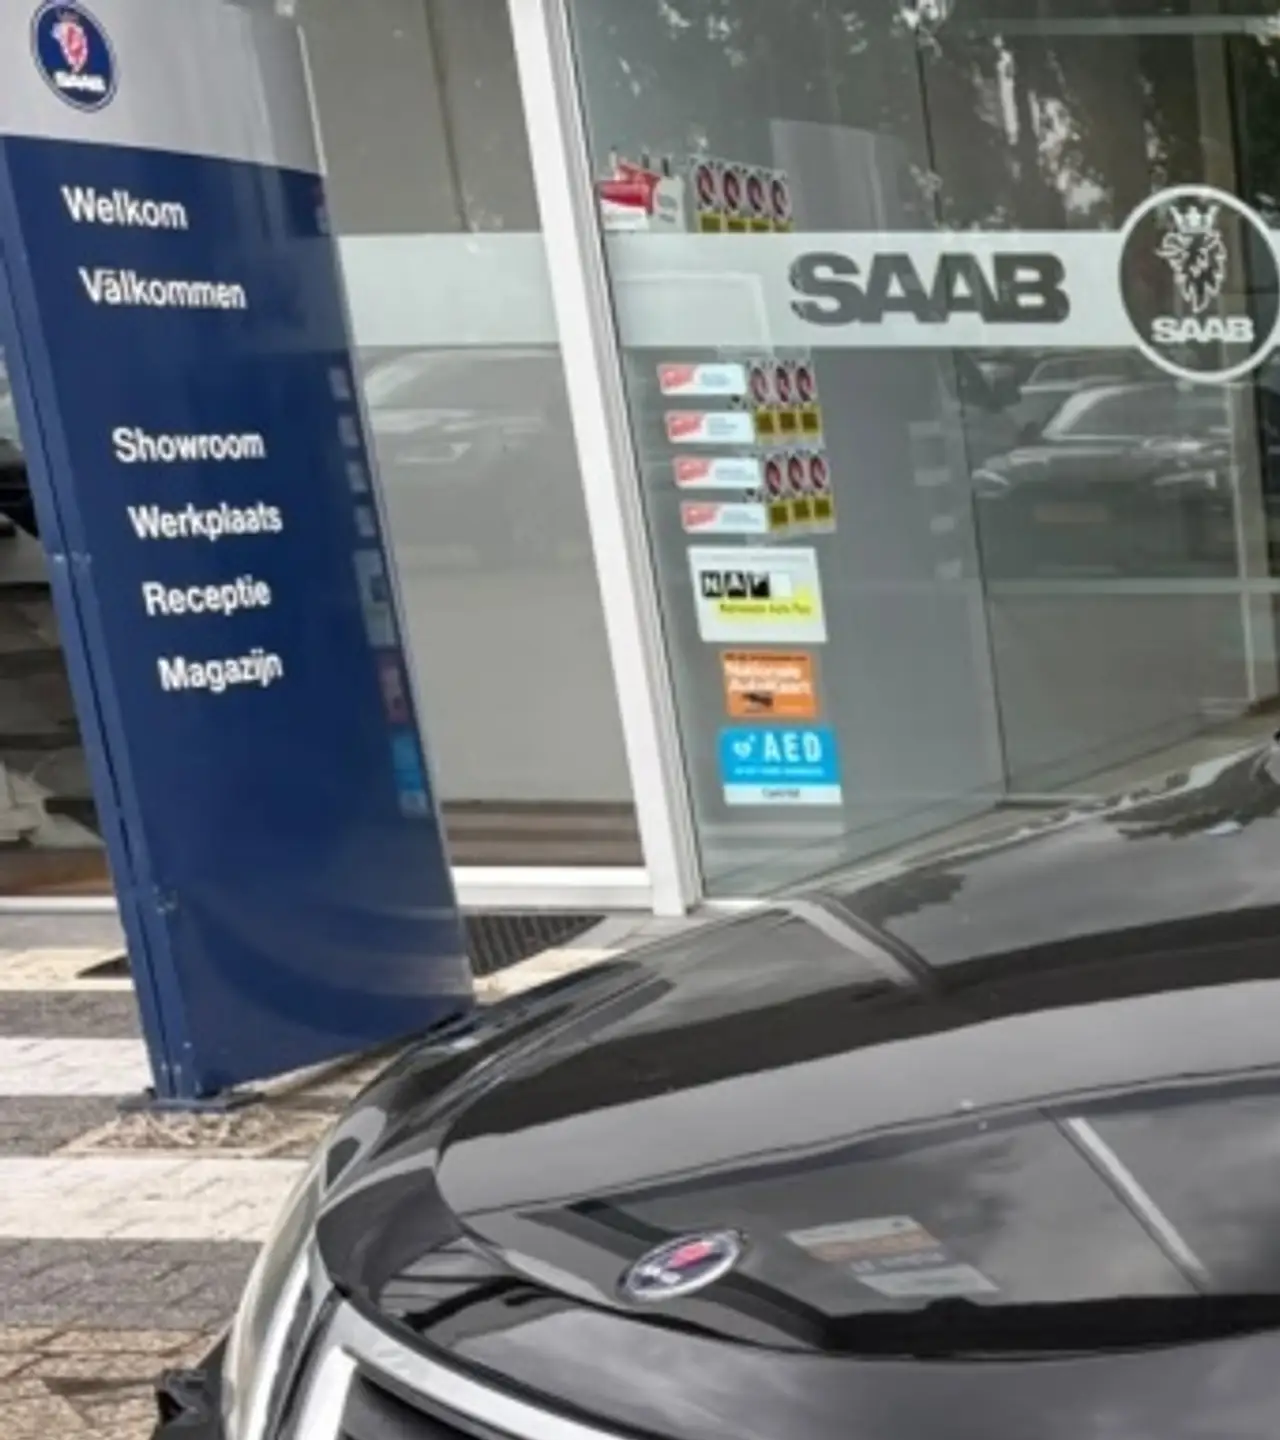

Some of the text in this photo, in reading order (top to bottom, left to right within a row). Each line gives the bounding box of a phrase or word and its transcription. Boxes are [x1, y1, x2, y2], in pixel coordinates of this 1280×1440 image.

[61, 185, 187, 229] Welkom
[78, 265, 248, 312] Välkommen
[789, 251, 1072, 325] SAAB
[1150, 315, 1255, 345] SAAB
[112, 426, 267, 465] Showroom
[127, 501, 284, 541] Werkplaats
[143, 574, 273, 618] Receptie
[158, 648, 285, 695] Magazijn
[763, 731, 822, 764] AED
